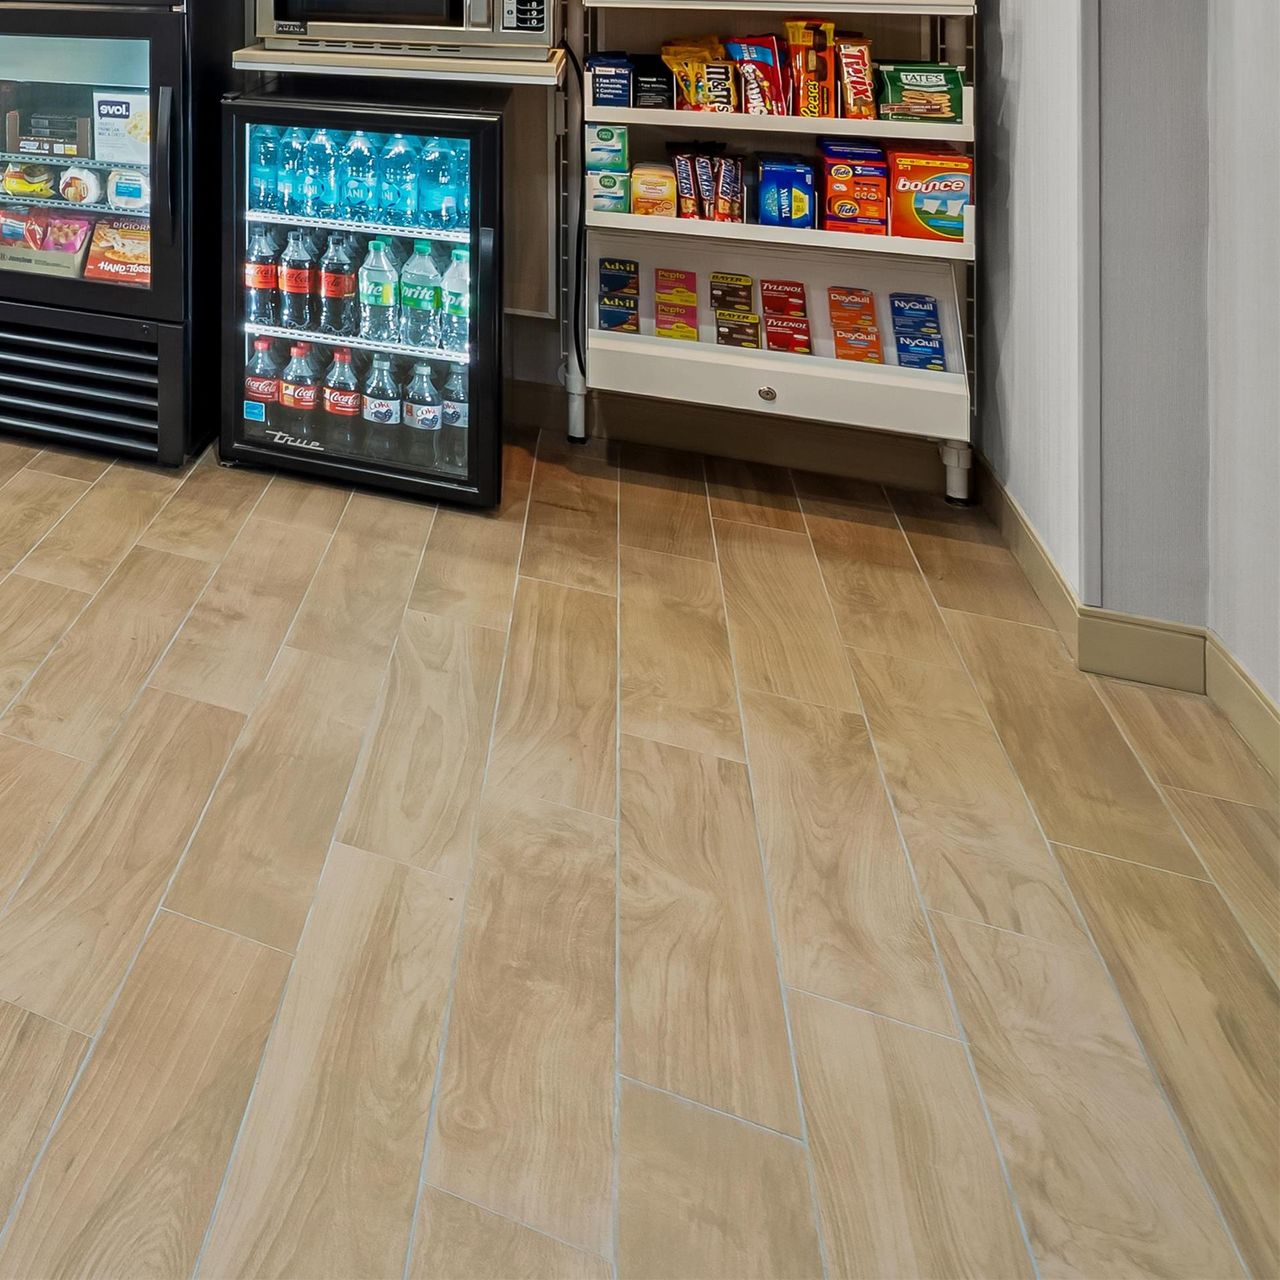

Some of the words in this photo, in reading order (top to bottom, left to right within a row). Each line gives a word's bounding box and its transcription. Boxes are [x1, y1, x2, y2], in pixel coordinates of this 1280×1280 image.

[902, 73, 943, 82] TATE'S
[834, 168, 851, 177] Tide
[854, 166, 862, 174] 3
[897, 178, 964, 193] bounce
[781, 188, 790, 218] TAMPAX
[837, 204, 858, 214] Tide
[602, 261, 635, 272] Advil
[658, 270, 686, 280] Pepto
[711, 274, 744, 283] BAYER
[762, 282, 803, 293] TYLENOL
[600, 297, 635, 308] Advil
[831, 293, 870, 304] DayQuil
[658, 304, 686, 314] Pepto
[894, 300, 933, 311] NyQuil
[718, 312, 750, 321] BAYER
[767, 319, 808, 329] TYLENOL
[836, 330, 877, 342] DayQuil
[900, 336, 940, 349] NyQuil
